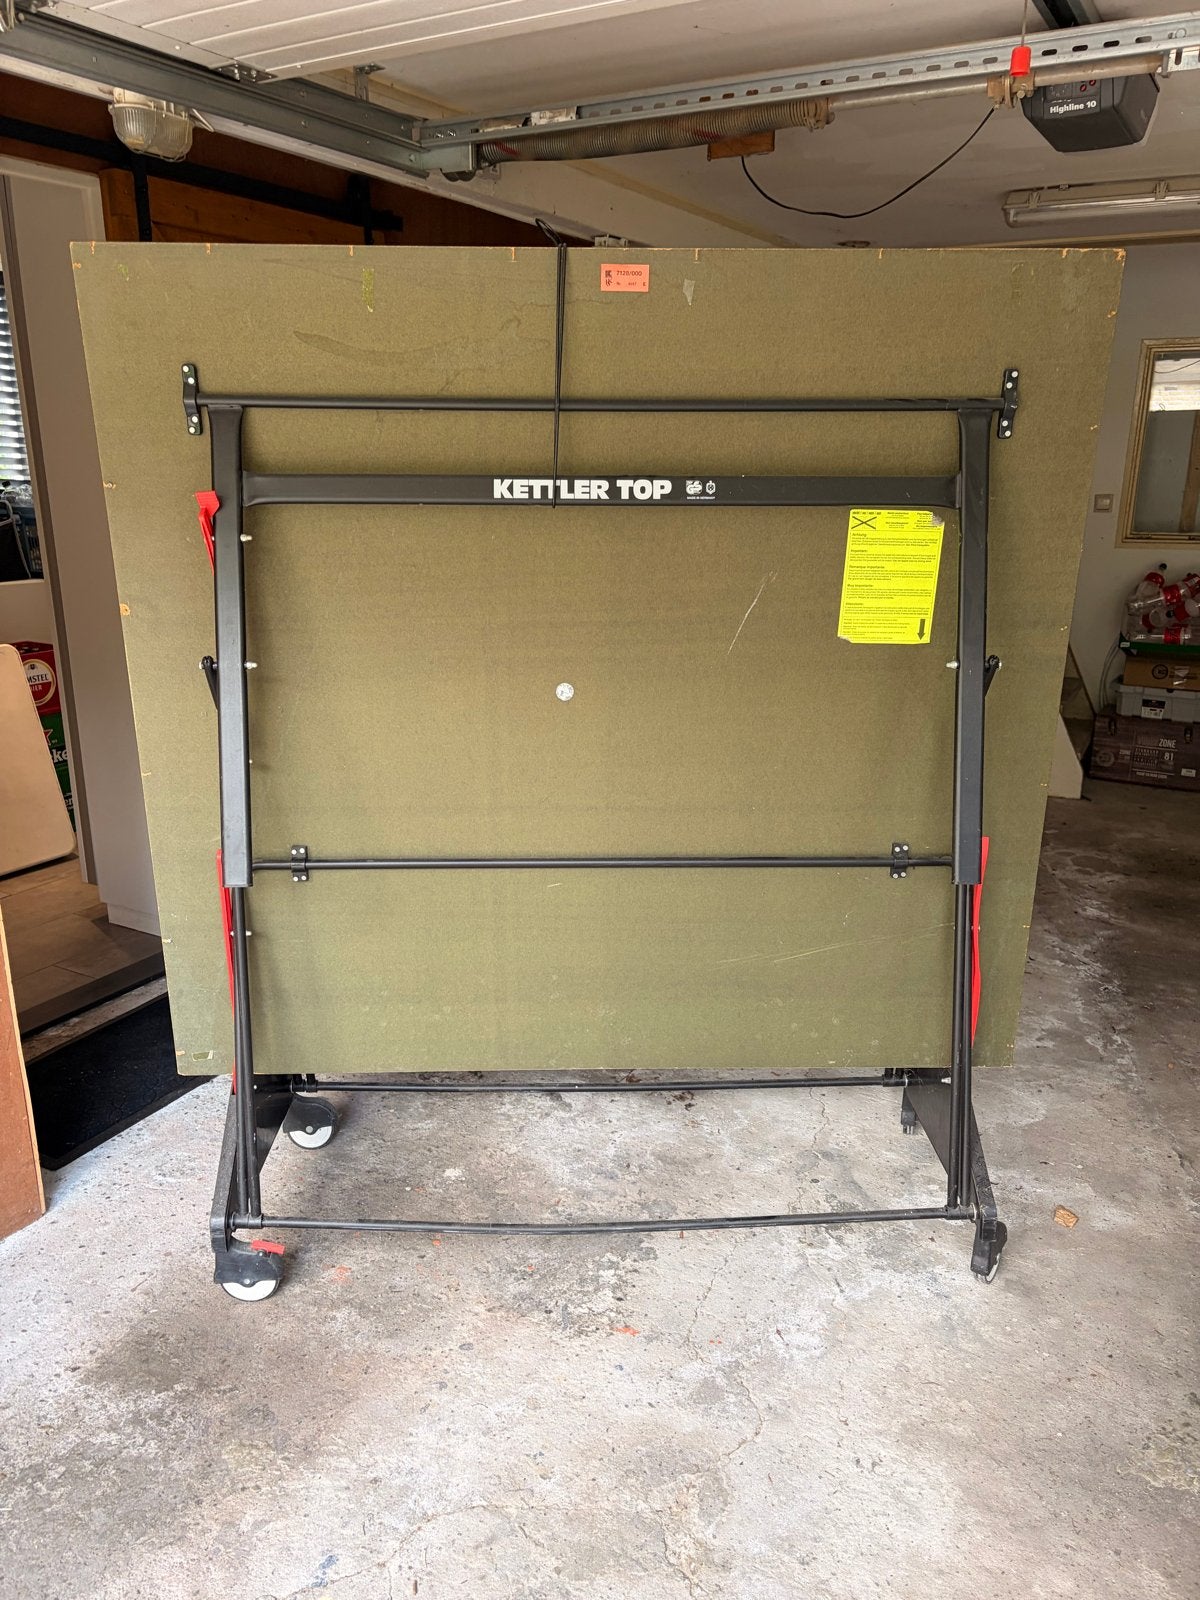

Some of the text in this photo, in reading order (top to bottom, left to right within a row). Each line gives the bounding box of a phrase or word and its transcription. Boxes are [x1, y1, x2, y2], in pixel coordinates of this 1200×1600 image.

[1050, 100, 1097, 114] Highline 10
[493, 478, 672, 500] KETTLER TOP
[27, 673, 49, 684] MSTEL
[1159, 738, 1177, 749] ZONE
[1164, 752, 1174, 761] 81
